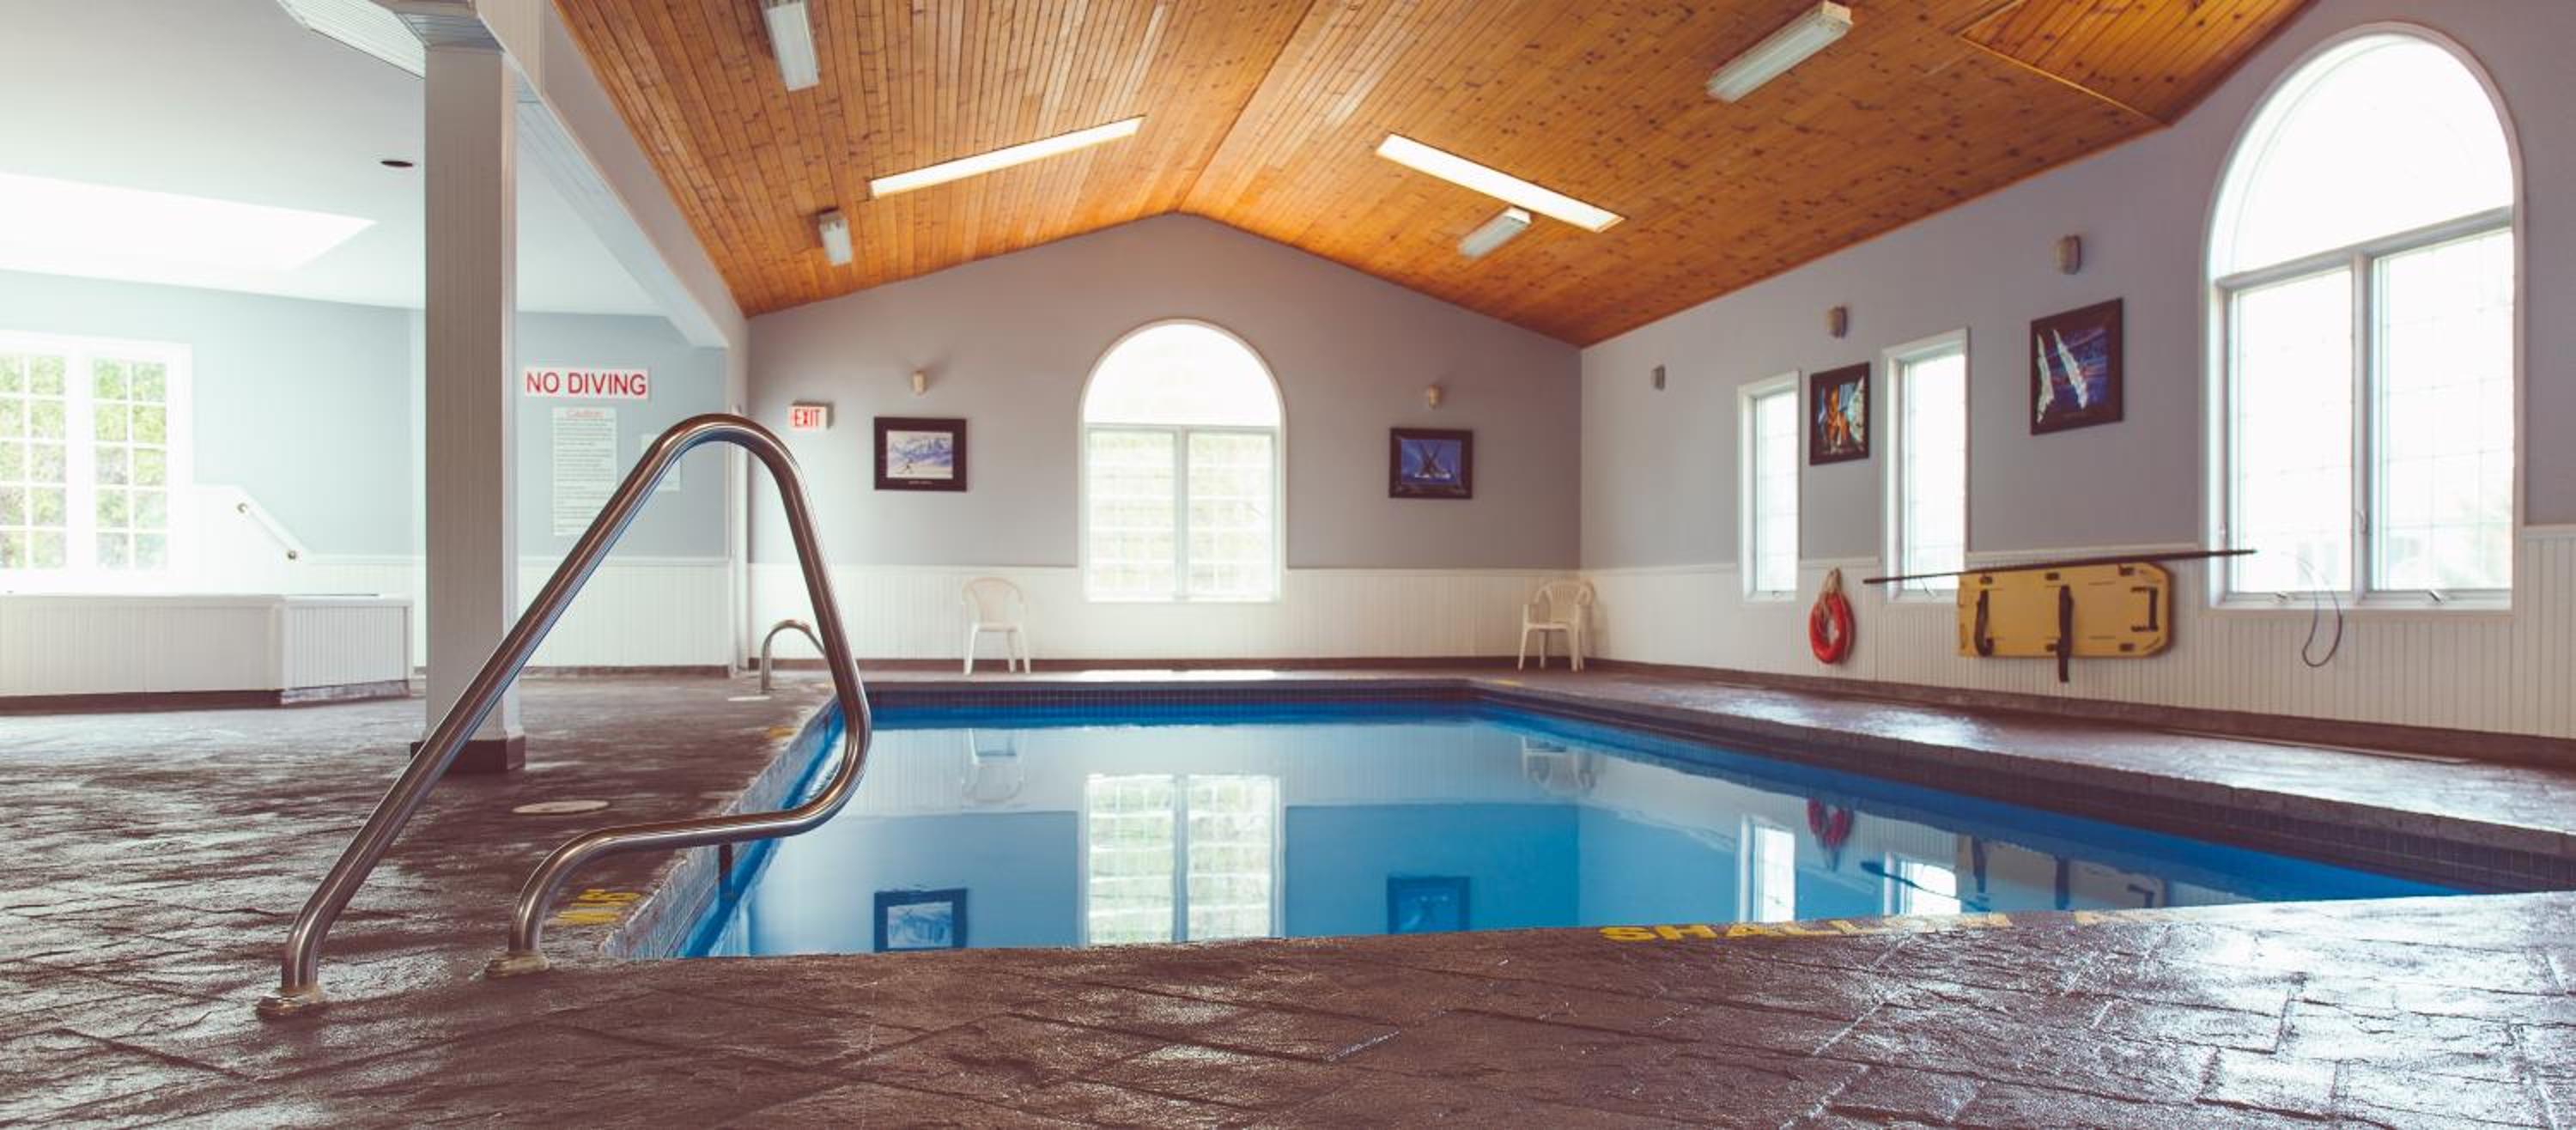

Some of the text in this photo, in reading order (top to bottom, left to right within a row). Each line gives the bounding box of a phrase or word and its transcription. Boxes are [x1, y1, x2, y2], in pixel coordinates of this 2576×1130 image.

[526, 371, 647, 396] NO DIVING
[794, 408, 821, 428] EXIT
